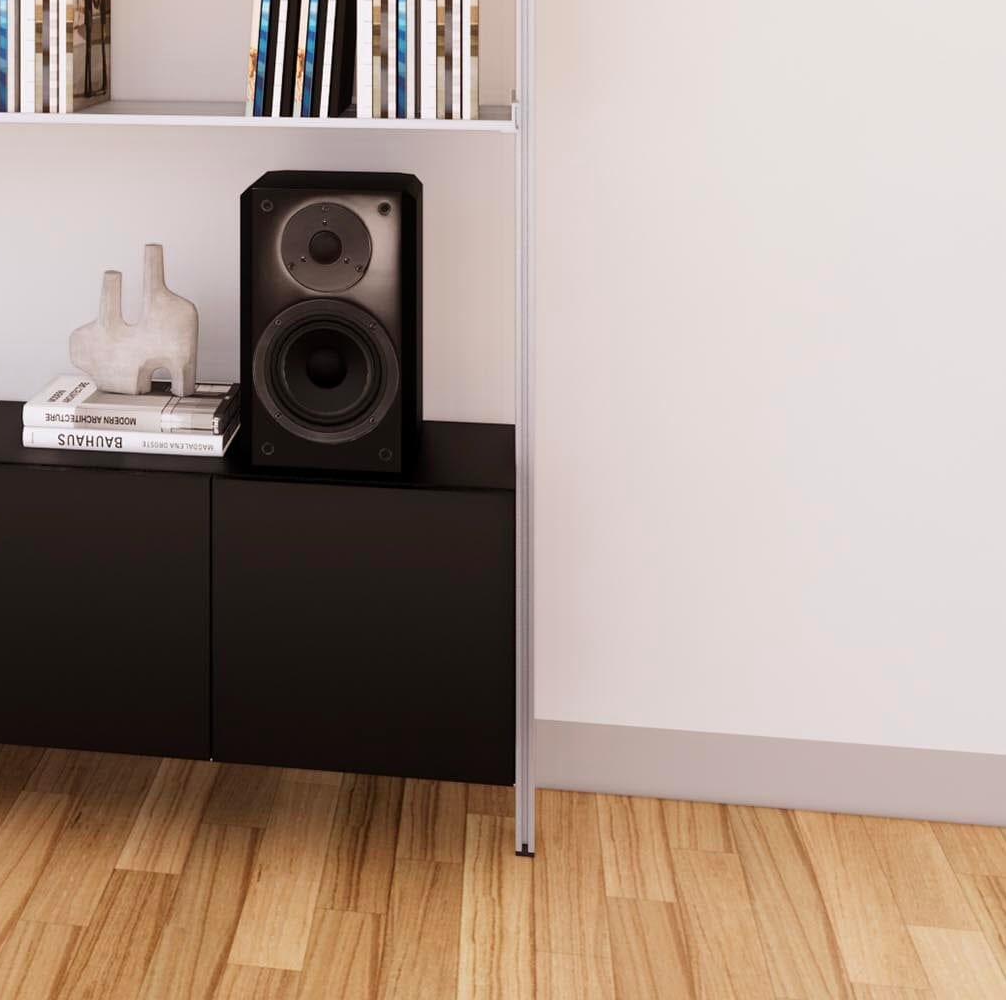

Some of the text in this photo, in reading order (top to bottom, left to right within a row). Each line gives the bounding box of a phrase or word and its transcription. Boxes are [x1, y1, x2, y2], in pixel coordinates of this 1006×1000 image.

[45, 413, 136, 425] MODERN ARCHITECTURE
[57, 434, 123, 449] BAUHAUS
